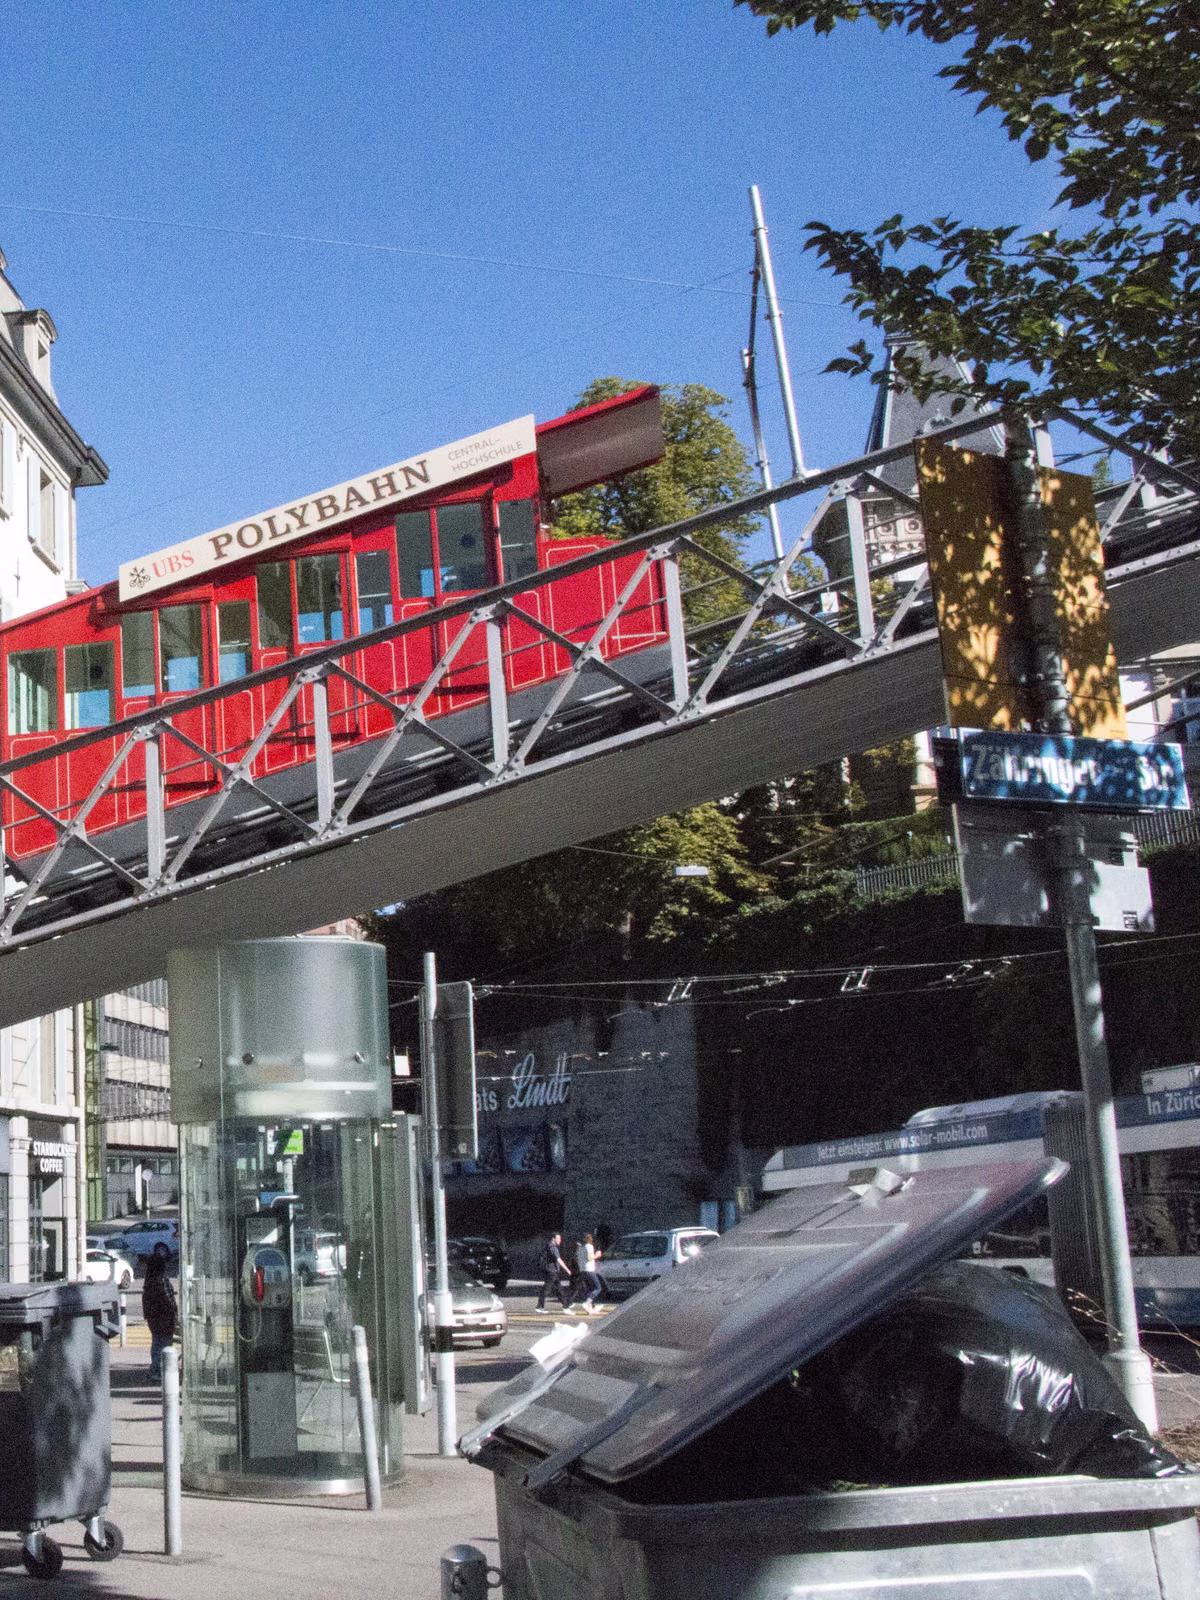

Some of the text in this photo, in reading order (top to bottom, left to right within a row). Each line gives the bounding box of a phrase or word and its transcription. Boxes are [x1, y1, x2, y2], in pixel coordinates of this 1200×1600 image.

[452, 441, 523, 472] HOCHSCHULE
[208, 459, 432, 561] POLYBAHN
[152, 550, 195, 579] UBS
[507, 1053, 572, 1109] Lindt
[1146, 1095, 1161, 1115] In
[33, 1141, 70, 1157] STARBUCKS
[884, 1124, 988, 1150] www.solar-mobil.com
[40, 1158, 63, 1173] COFFEE
